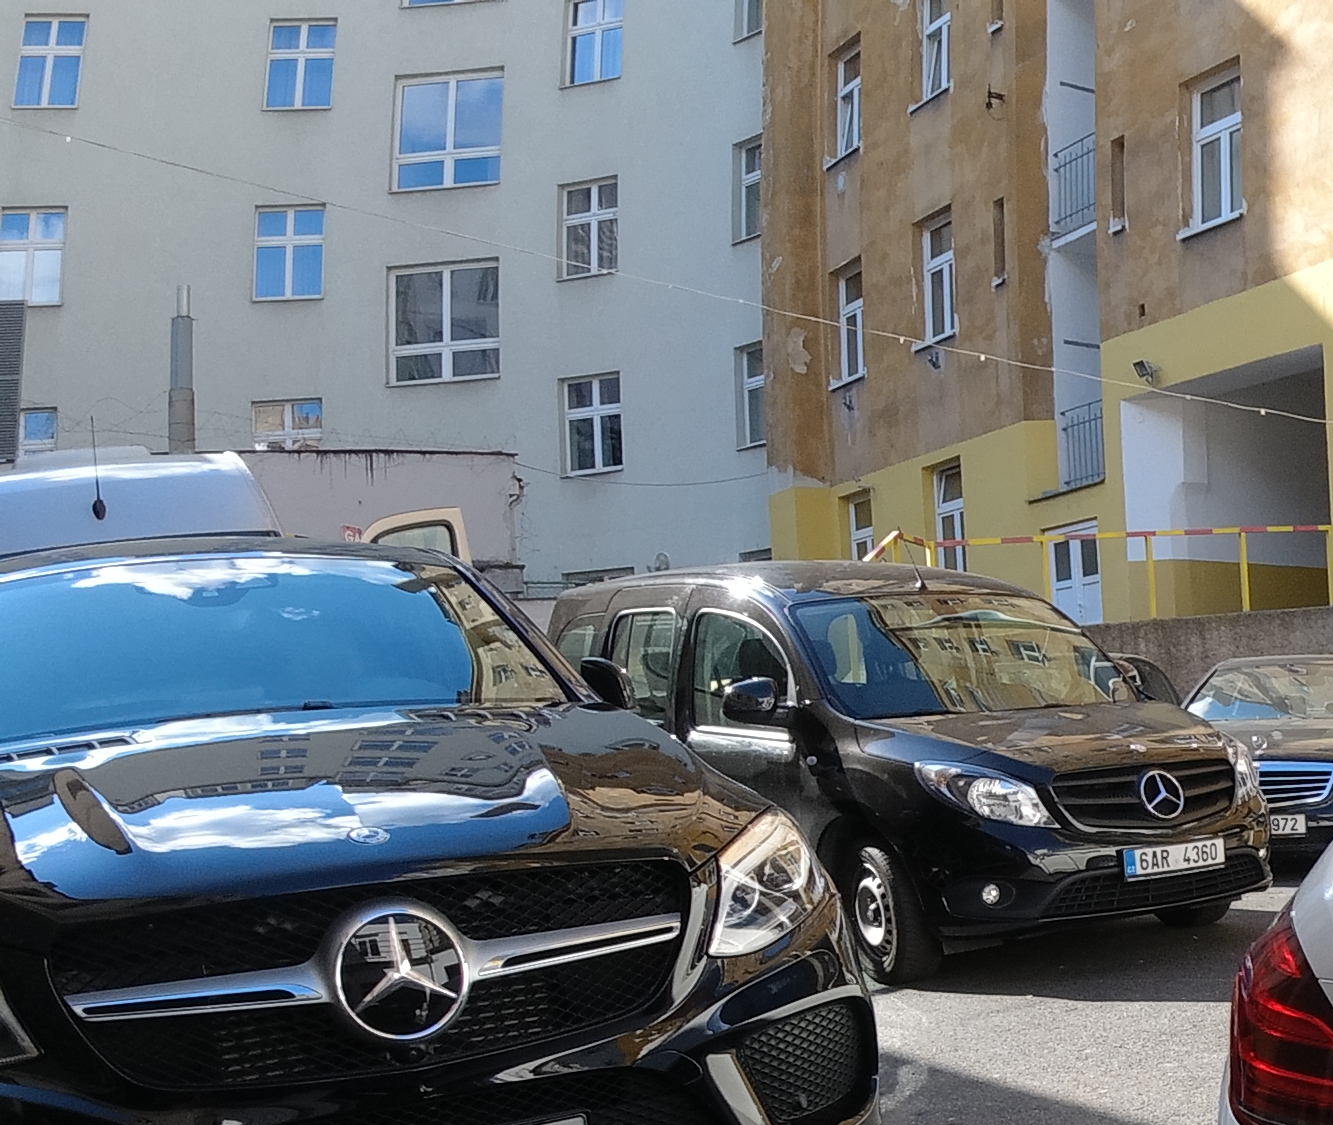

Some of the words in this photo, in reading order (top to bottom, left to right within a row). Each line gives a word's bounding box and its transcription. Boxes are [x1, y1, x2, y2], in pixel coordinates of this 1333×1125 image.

[1271, 816, 1300, 832] 972
[1139, 849, 1171, 871] 6AR
[1182, 842, 1218, 865] 4360
